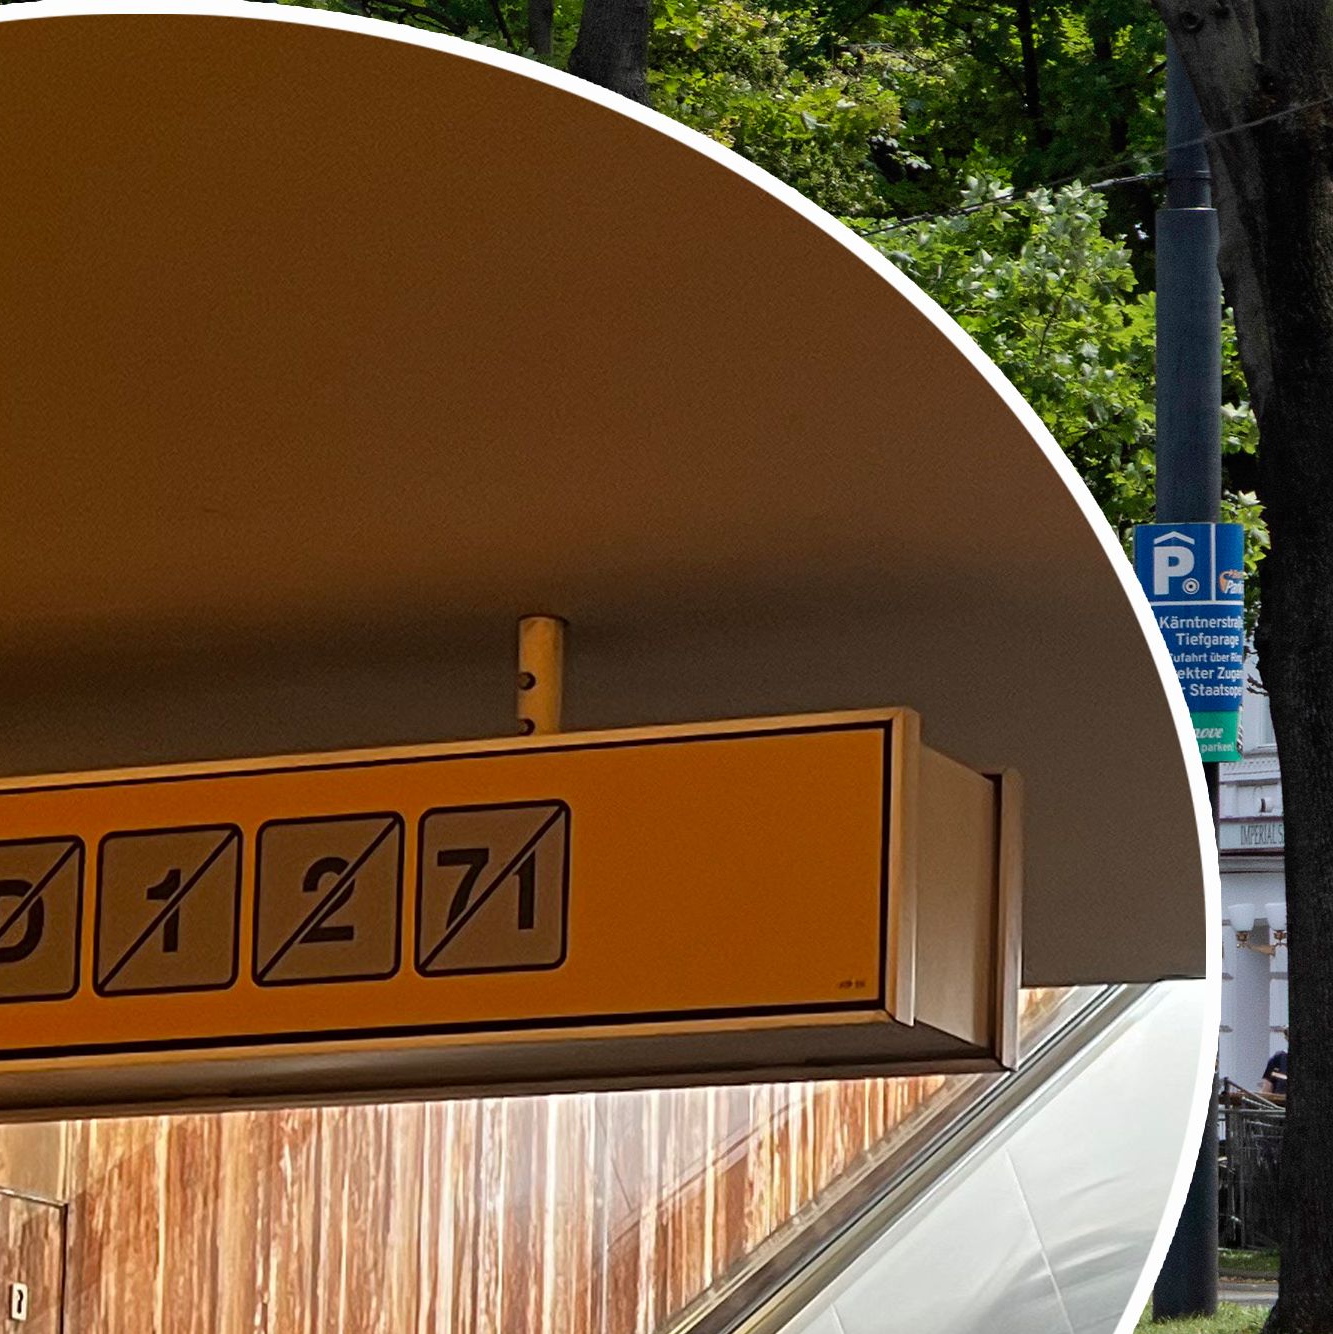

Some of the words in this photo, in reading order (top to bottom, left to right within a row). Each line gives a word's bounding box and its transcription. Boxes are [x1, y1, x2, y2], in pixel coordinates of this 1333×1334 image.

[1175, 632, 1240, 648] Tiefgarage
[1210, 652, 1229, 663] über
[1177, 666, 1215, 679] ekter
[1190, 684, 1242, 698] Staatsope
[1240, 823, 1277, 845] IMPERIAL
[146, 868, 182, 953] 1
[297, 856, 356, 944] 2
[436, 847, 536, 931] 71
